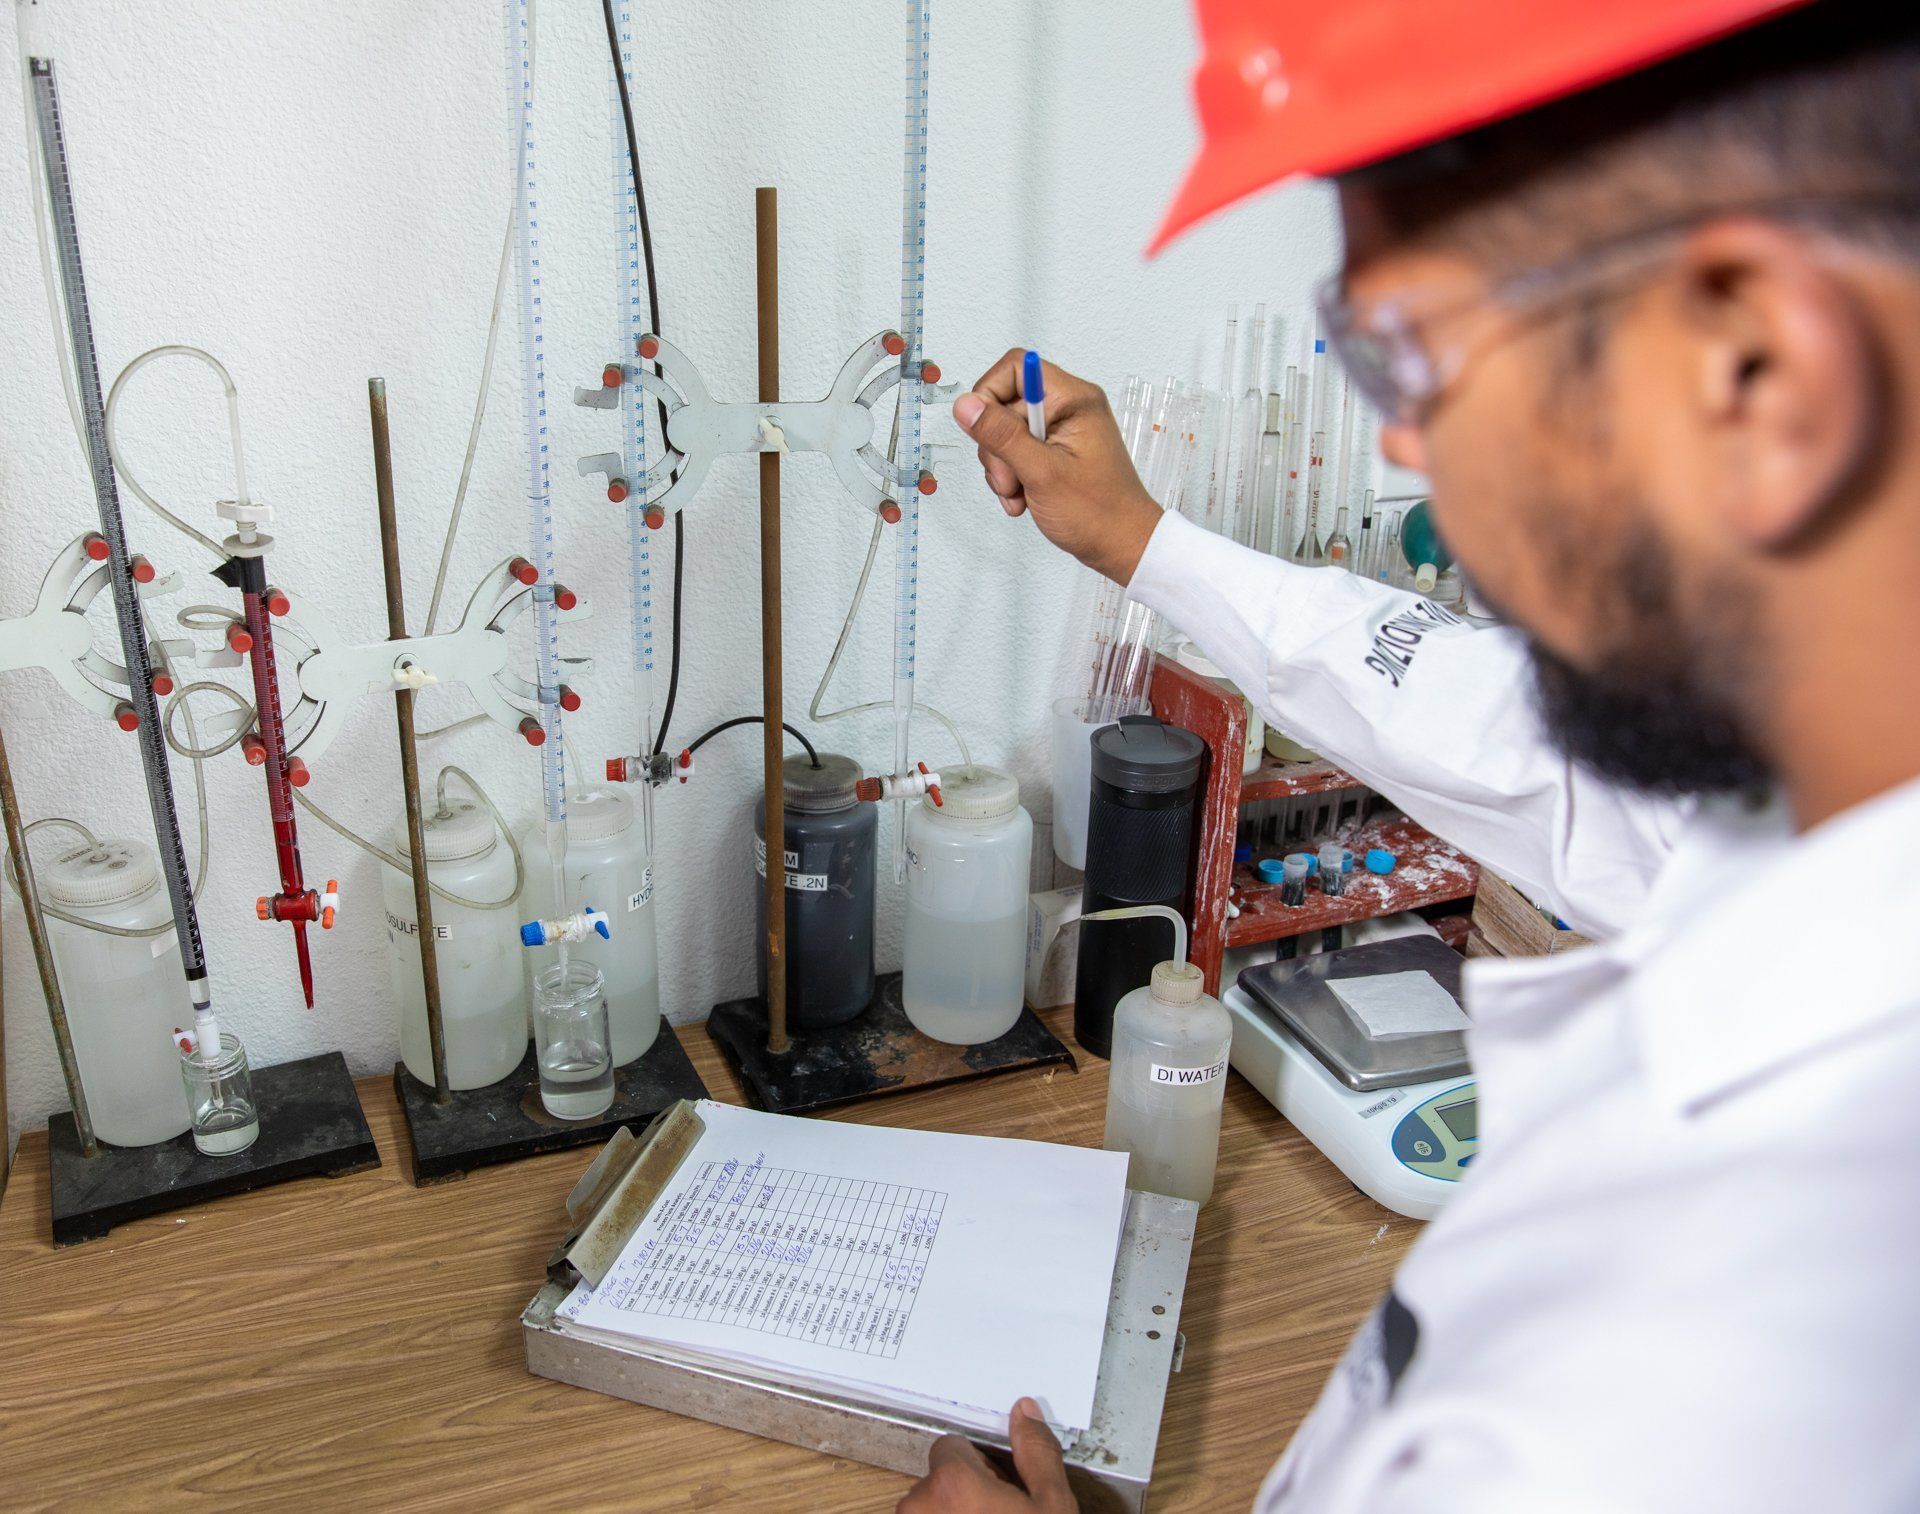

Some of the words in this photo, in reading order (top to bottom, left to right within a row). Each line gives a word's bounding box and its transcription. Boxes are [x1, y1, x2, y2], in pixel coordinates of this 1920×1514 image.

[622, 13, 630, 21] 13
[623, 53, 632, 61] 15
[636, 419, 644, 427] 35
[640, 552, 649, 560] 43
[644, 647, 653, 655] 49
[802, 877, 825, 888] .2N
[1157, 1068, 1173, 1082] DI
[1178, 1061, 1225, 1083] WATER
[656, 1216, 669, 1231] Process
[664, 1207, 675, 1217] Tank
[670, 1192, 684, 1208] Analysis
[681, 1201, 691, 1211] Value
[676, 1209, 687, 1220] High
[898, 1232, 908, 1246] 2.50%
[911, 1234, 920, 1248] 2.50%
[923, 1236, 933, 1250] 2.50%
[746, 1237, 761, 1256] 206
[760, 1238, 776, 1256] 206
[653, 1248, 664, 1259] Value
[784, 1244, 802, 1262] 206
[796, 1246, 813, 1264] 206
[648, 1257, 657, 1268] Low
[640, 1272, 651, 1283] Type
[634, 1283, 644, 1293] Tank
[649, 1279, 659, 1291] Soap
[659, 1281, 672, 1297] Caustic
[672, 1280, 685, 1299] Additive
[684, 1284, 697, 1300] Caustic
[697, 1283, 710, 1302] Additive
[723, 1288, 735, 1305] Anodize
[735, 1290, 748, 1308] Anodize
[749, 1292, 761, 1310] Anodize
[762, 1295, 775, 1312] Anodize
[775, 1297, 787, 1315] Anodize
[787, 1305, 797, 1318] Color
[800, 1308, 810, 1321] Color
[814, 1312, 823, 1323] Acid
[827, 1313, 836, 1326] Color
[870, 1314, 879, 1324] Seal
[854, 1320, 863, 1331] Acid
[883, 1316, 892, 1327] Seal
[897, 1319, 905, 1329] Seal
[866, 1323, 877, 1334] Mag
[880, 1326, 891, 1337] Mag
[893, 1328, 904, 1339] Mag
